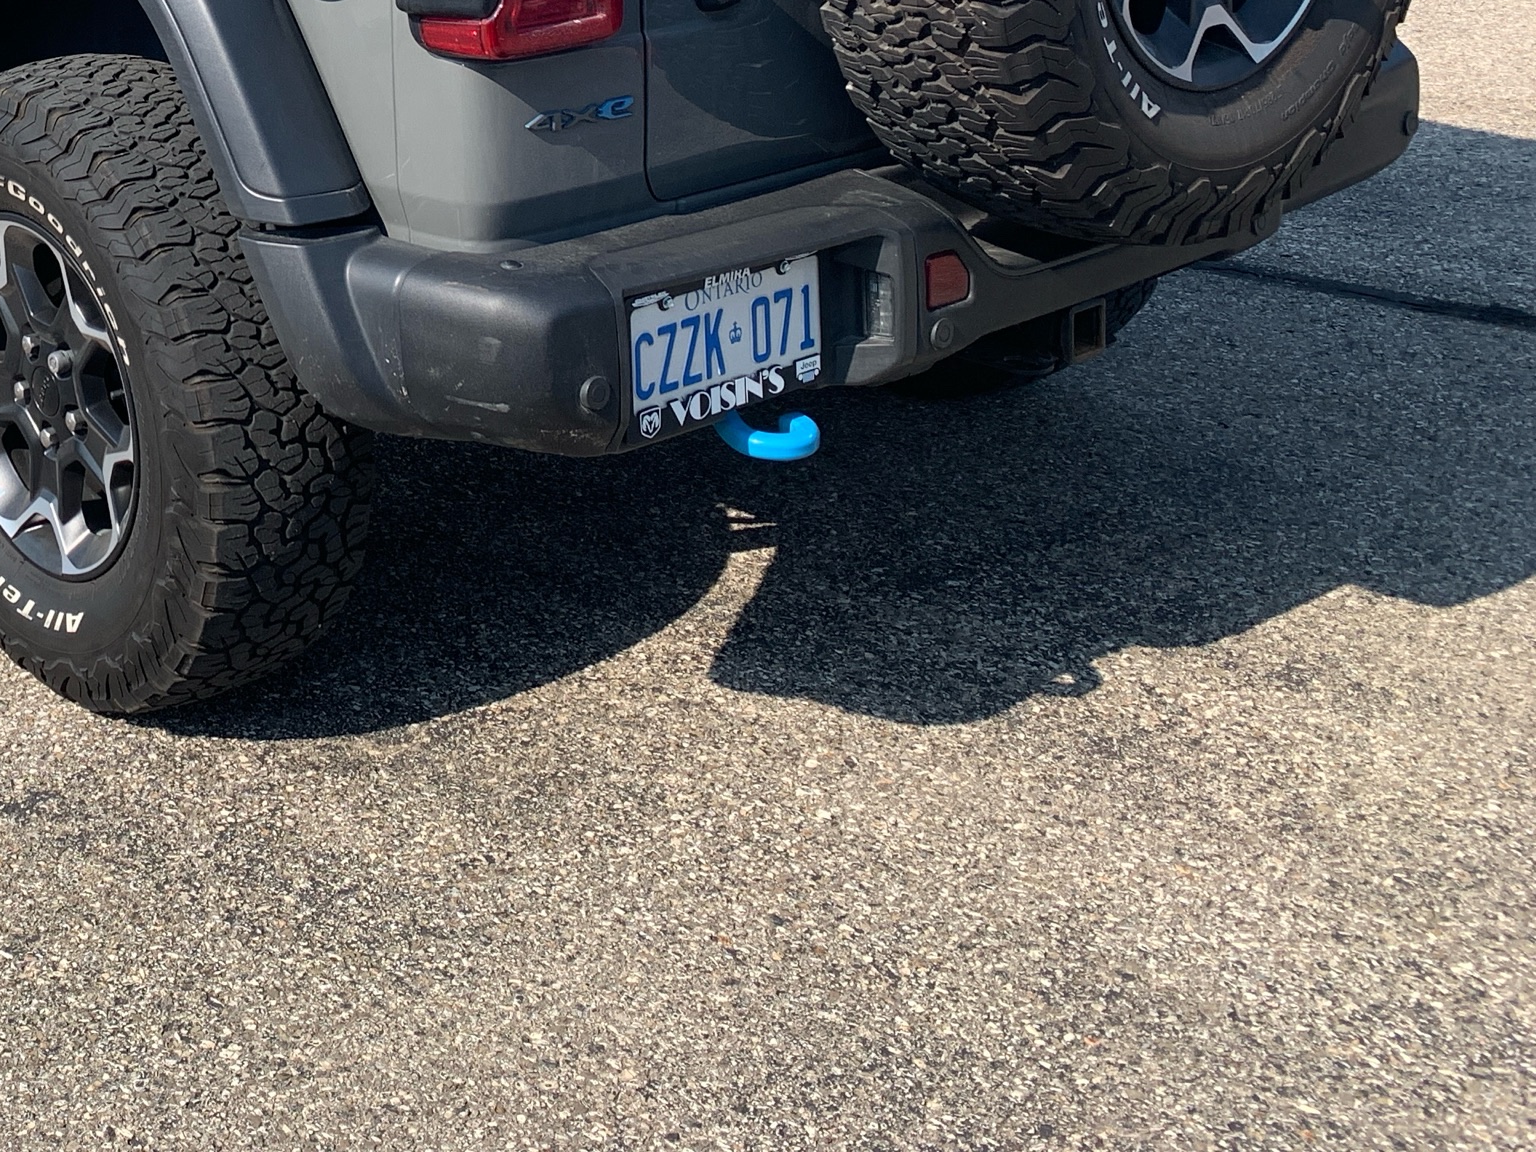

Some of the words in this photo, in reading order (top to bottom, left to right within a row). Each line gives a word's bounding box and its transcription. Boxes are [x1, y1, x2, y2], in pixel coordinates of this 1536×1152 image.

[634, 308, 726, 401] CZZK
[751, 284, 815, 363] 071
[800, 359, 817, 370] Jeep
[670, 365, 785, 426] VOISIN'S
